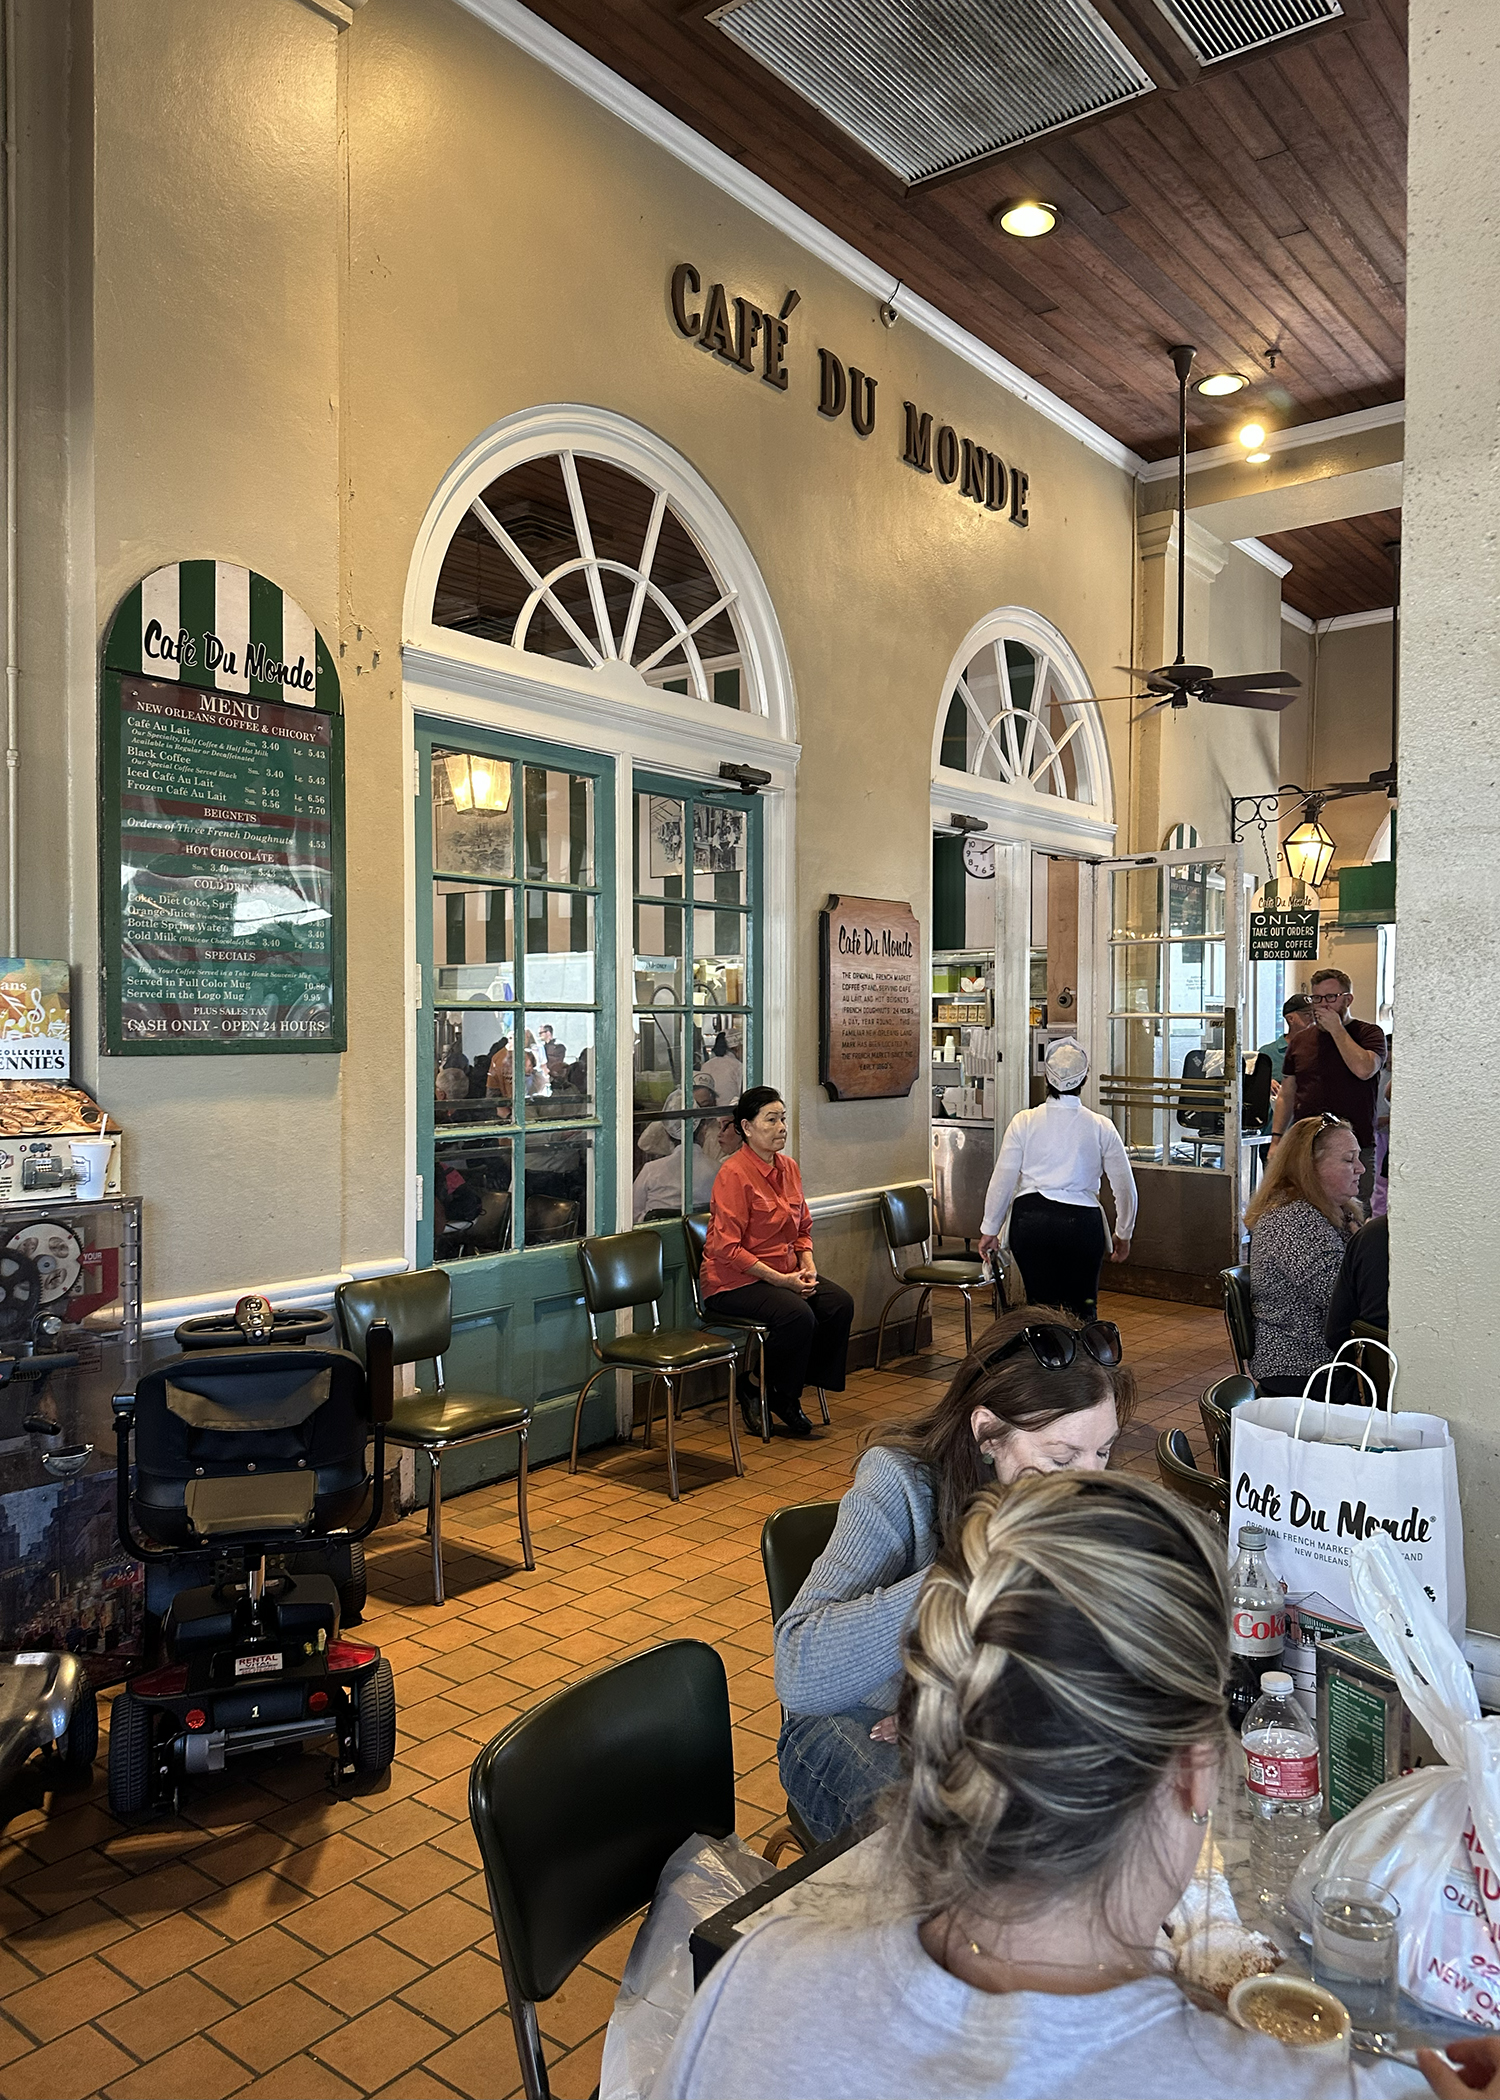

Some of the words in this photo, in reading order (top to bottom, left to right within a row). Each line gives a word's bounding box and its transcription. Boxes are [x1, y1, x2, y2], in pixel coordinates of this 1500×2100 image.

[670, 263, 802, 392] CAFÉ
[817, 347, 878, 437] DU
[902, 401, 1029, 528] MONDE
[144, 618, 198, 666] Café
[203, 631, 238, 674] Du
[244, 642, 315, 692] Monde
[199, 694, 261, 721] MENU
[136, 701, 163, 714] NEW
[164, 706, 216, 724] ORLEANS
[218, 716, 260, 733] COFFEE
[261, 725, 270, 734] &
[271, 726, 317, 743] CHICORY
[127, 716, 151, 729] Café
[153, 721, 168, 732] Au
[170, 724, 191, 736] Lait
[262, 741, 280, 752] 3.40
[308, 749, 326, 760] 5.43
[132, 728, 146, 736] Our
[147, 731, 181, 743] Specialty,
[182, 736, 197, 746] Half
[198, 740, 218, 749] Coffee
[226, 744, 241, 753] Half
[254, 749, 269, 758] Milk
[132, 737, 165, 749] Available
[175, 744, 202, 755] Regular
[211, 749, 255, 763] Decaffeinated
[127, 746, 157, 759] Black
[160, 751, 192, 764] Coffee
[266, 768, 284, 779] 3.40
[308, 776, 326, 786] 5.43
[147, 760, 173, 770] Special
[174, 764, 195, 774] Coffee
[196, 767, 217, 777] Served
[218, 770, 238, 780] Black
[127, 767, 150, 779] Iced
[153, 770, 176, 783] Café
[177, 774, 192, 785] Au
[194, 777, 215, 788] Lait
[262, 788, 280, 798] 5.43
[308, 794, 326, 805] 6.56
[127, 779, 164, 793] Frozen
[166, 784, 189, 797] Café
[190, 789, 205, 799] Au
[207, 791, 227, 802] Lait
[262, 799, 280, 809] 6.56
[308, 806, 326, 816] 7.70
[204, 807, 257, 823] BEIGNETS
[127, 817, 163, 830] Orders
[165, 822, 176, 833] of
[177, 823, 206, 835] Three
[207, 827, 241, 839] French
[243, 831, 294, 845] Doughnuts
[309, 841, 326, 850] 4.53
[185, 844, 209, 856] HOT
[211, 847, 275, 863] CHOCOLATE
[210, 864, 229, 873] 3.40
[194, 879, 224, 890] COLD
[227, 882, 266, 894] DRINKS
[159, 895, 180, 906] Diet
[182, 896, 210, 909] Coke,
[1258, 897, 1275, 909] Café
[1275, 896, 1287, 908] Du
[1288, 895, 1312, 908] Monde
[128, 905, 167, 918] Orange
[168, 908, 196, 919] Juice
[1255, 914, 1313, 926] ONLY
[128, 918, 159, 929] Bottle
[161, 920, 198, 933] Spring
[198, 922, 227, 933] Water
[308, 930, 325, 939] 3.40
[1252, 927, 1269, 937] TAKE
[1270, 927, 1286, 937] OUT
[1287, 926, 1315, 937] ORDERS
[127, 930, 151, 941] Cold
[154, 932, 177, 942] Milk
[180, 936, 201, 944] (White
[262, 938, 281, 948] 3.40
[308, 941, 325, 951] 4.53
[839, 925, 862, 956] Café
[864, 928, 881, 956] Du
[882, 929, 913, 959] Monde
[1252, 940, 1279, 950] CANNED
[1285, 940, 1314, 949] COFFEE
[205, 950, 256, 962] SPECIALS
[1263, 950, 1291, 959] BOXED
[1292, 950, 1309, 959] MIX
[158, 967, 175, 975] Your
[175, 968, 196, 976] Coffee
[234, 970, 251, 978] Take
[842, 972, 852, 980] THE
[853, 972, 875, 980] ORIGINAL
[894, 974, 912, 982] MARKET
[127, 976, 163, 987] Served
[165, 977, 176, 987] in
[178, 978, 200, 988] Full
[201, 979, 228, 988] Color
[230, 979, 252, 990] Mug
[127, 989, 163, 999] Served
[165, 989, 176, 999] in
[178, 990, 196, 1000] the
[197, 991, 222, 1001] Logo
[224, 991, 245, 1001] Mug
[193, 1007, 218, 1016] PLUS
[219, 1007, 249, 1016] SALES
[250, 1008, 268, 1016] TAX
[127, 1018, 167, 1032] CASH
[171, 1020, 211, 1032] ONLY
[221, 1020, 261, 1032] OPEN
[263, 1020, 277, 1032] 24
[280, 1020, 326, 1032] HOURS
[0, 1056, 65, 1070] ENNIES
[83, 1252, 102, 1261] YOUR
[1236, 1472, 1282, 1522] Café
[1290, 1490, 1330, 1533] Du
[1337, 1500, 1432, 1543] Monde
[1283, 1532, 1316, 1548] FRENCH
[1295, 1547, 1313, 1558] NEW
[239, 1655, 279, 1666] RENTAL
[252, 1706, 259, 1718] 1
[1428, 1957, 1474, 1993] NEW
